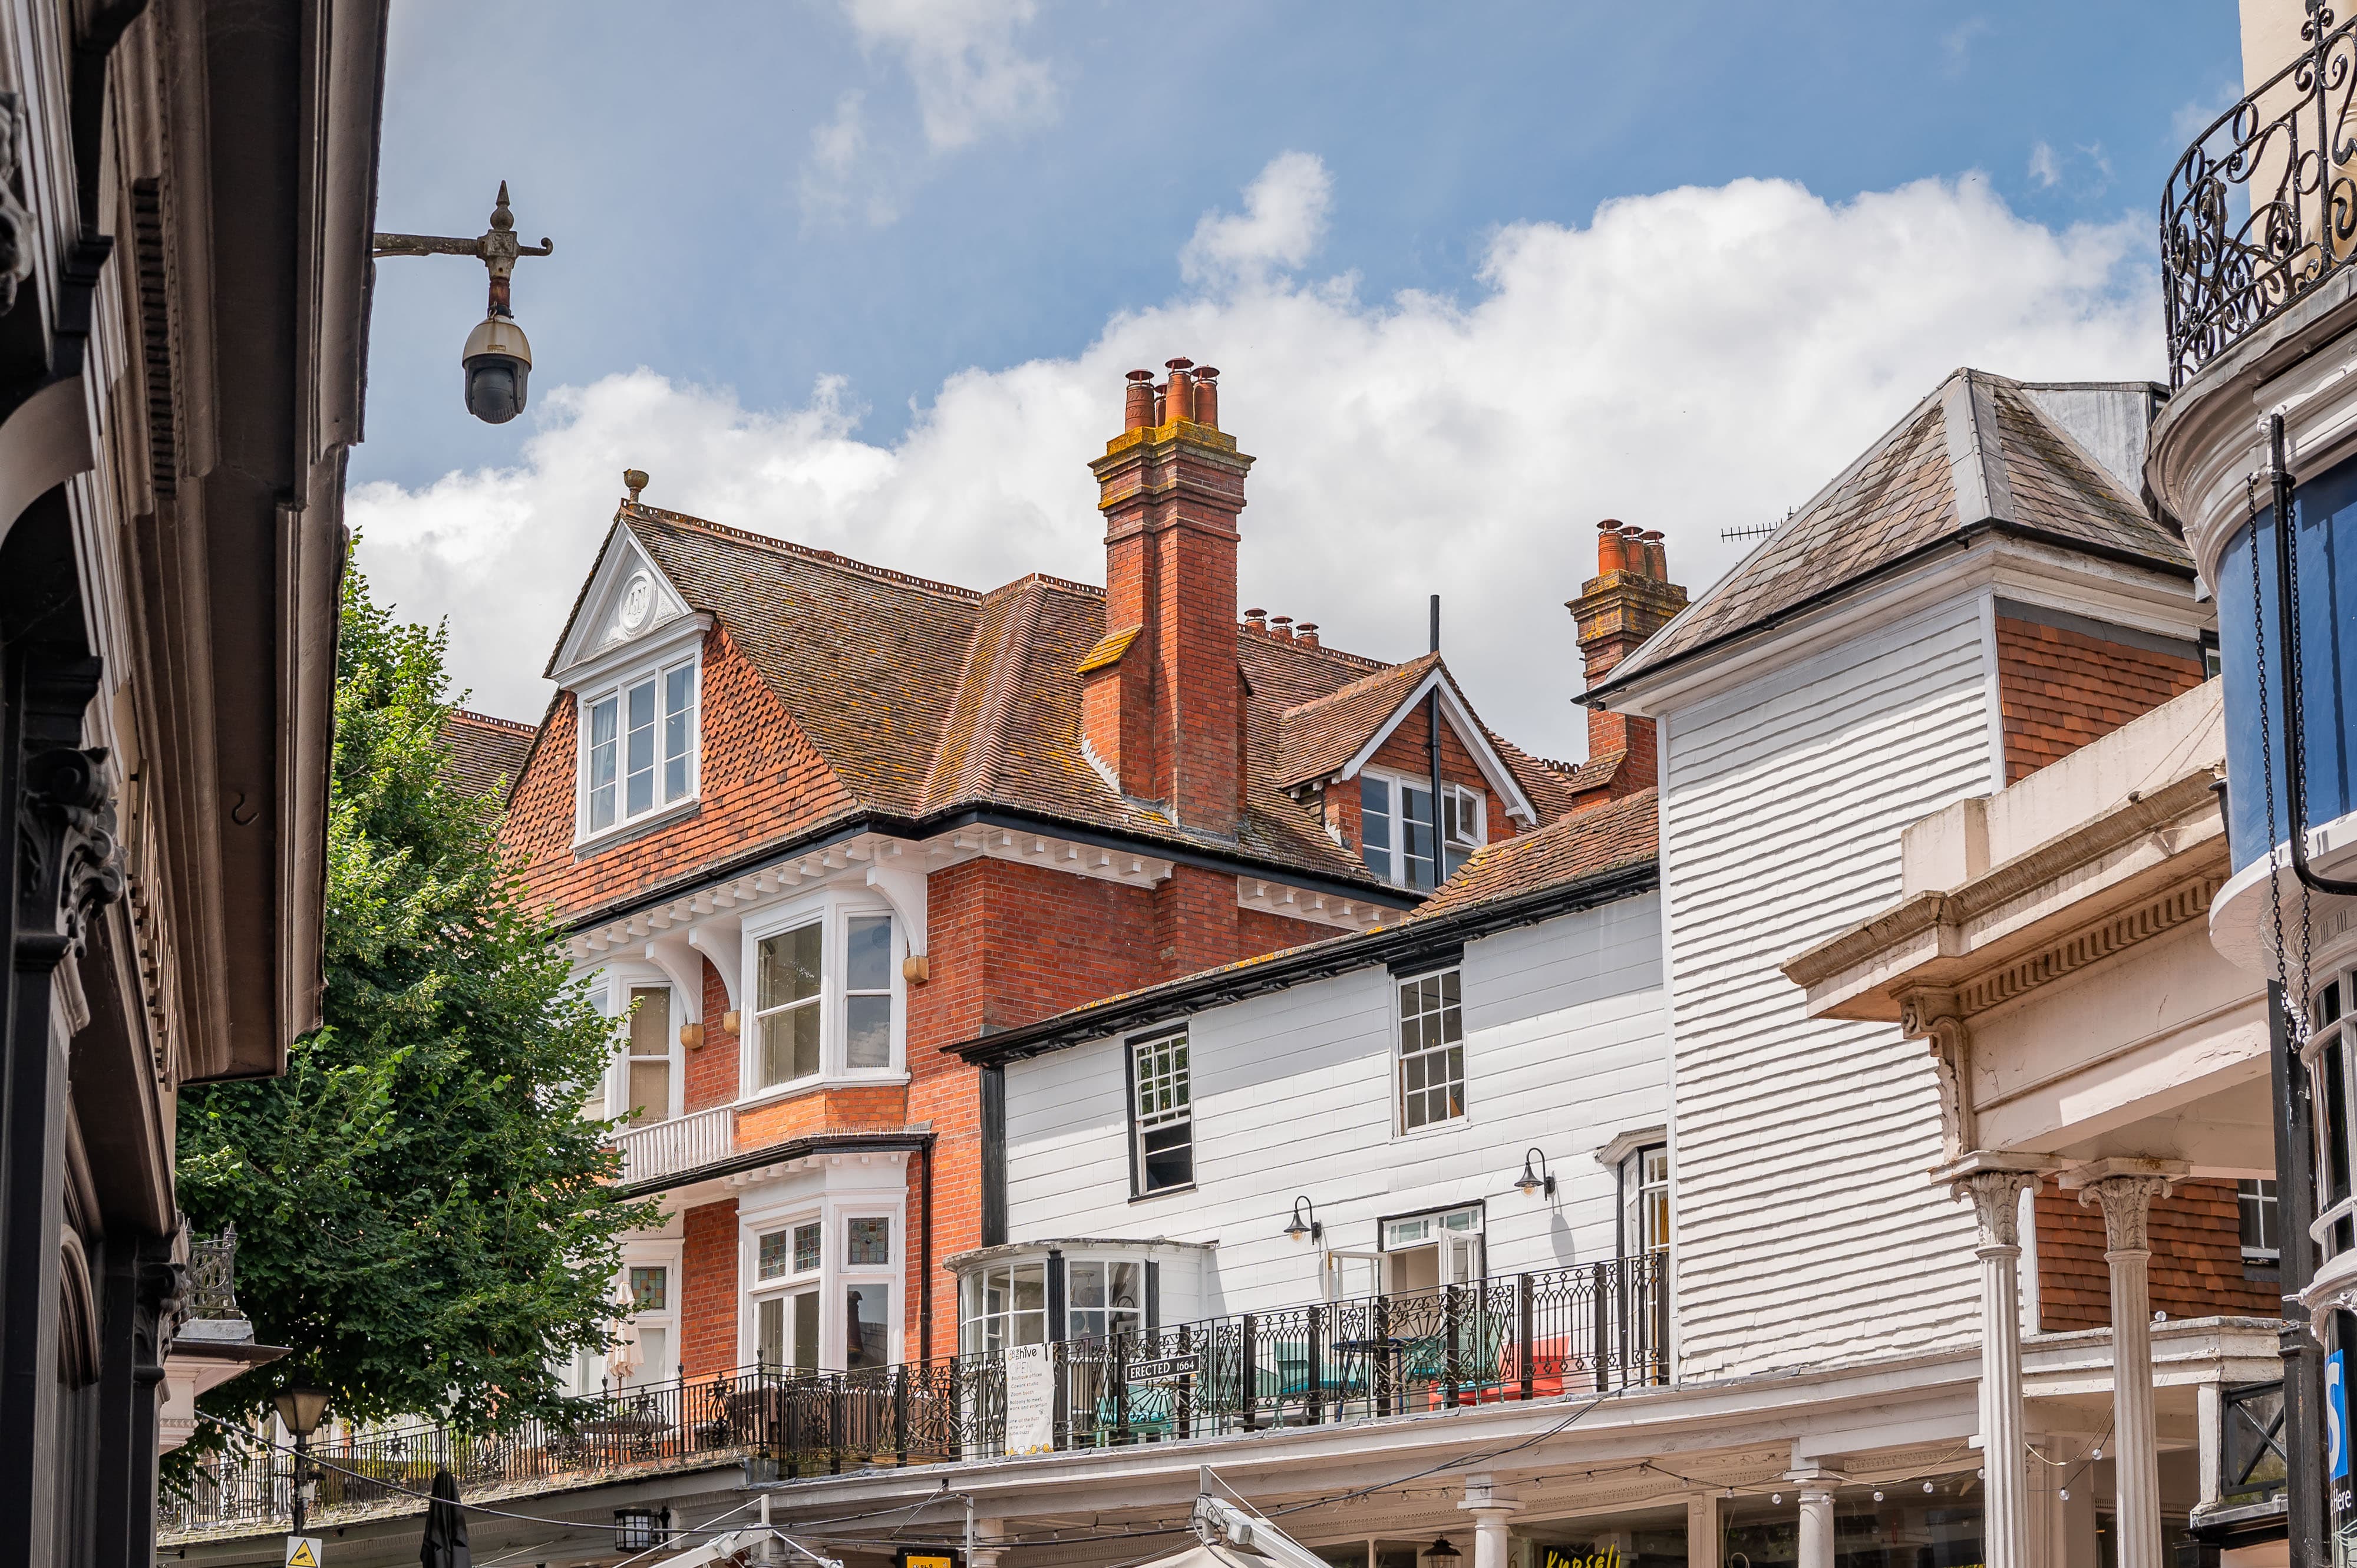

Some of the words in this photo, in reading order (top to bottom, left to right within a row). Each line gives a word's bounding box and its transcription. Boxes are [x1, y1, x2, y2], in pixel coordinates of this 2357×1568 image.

[1019, 1346, 1037, 1359] hive
[1009, 1361, 1032, 1375] OPEN
[1130, 1362, 1170, 1379] ERECTED
[1177, 1359, 1194, 1372] 1664
[2333, 1488, 2352, 1514] Here
